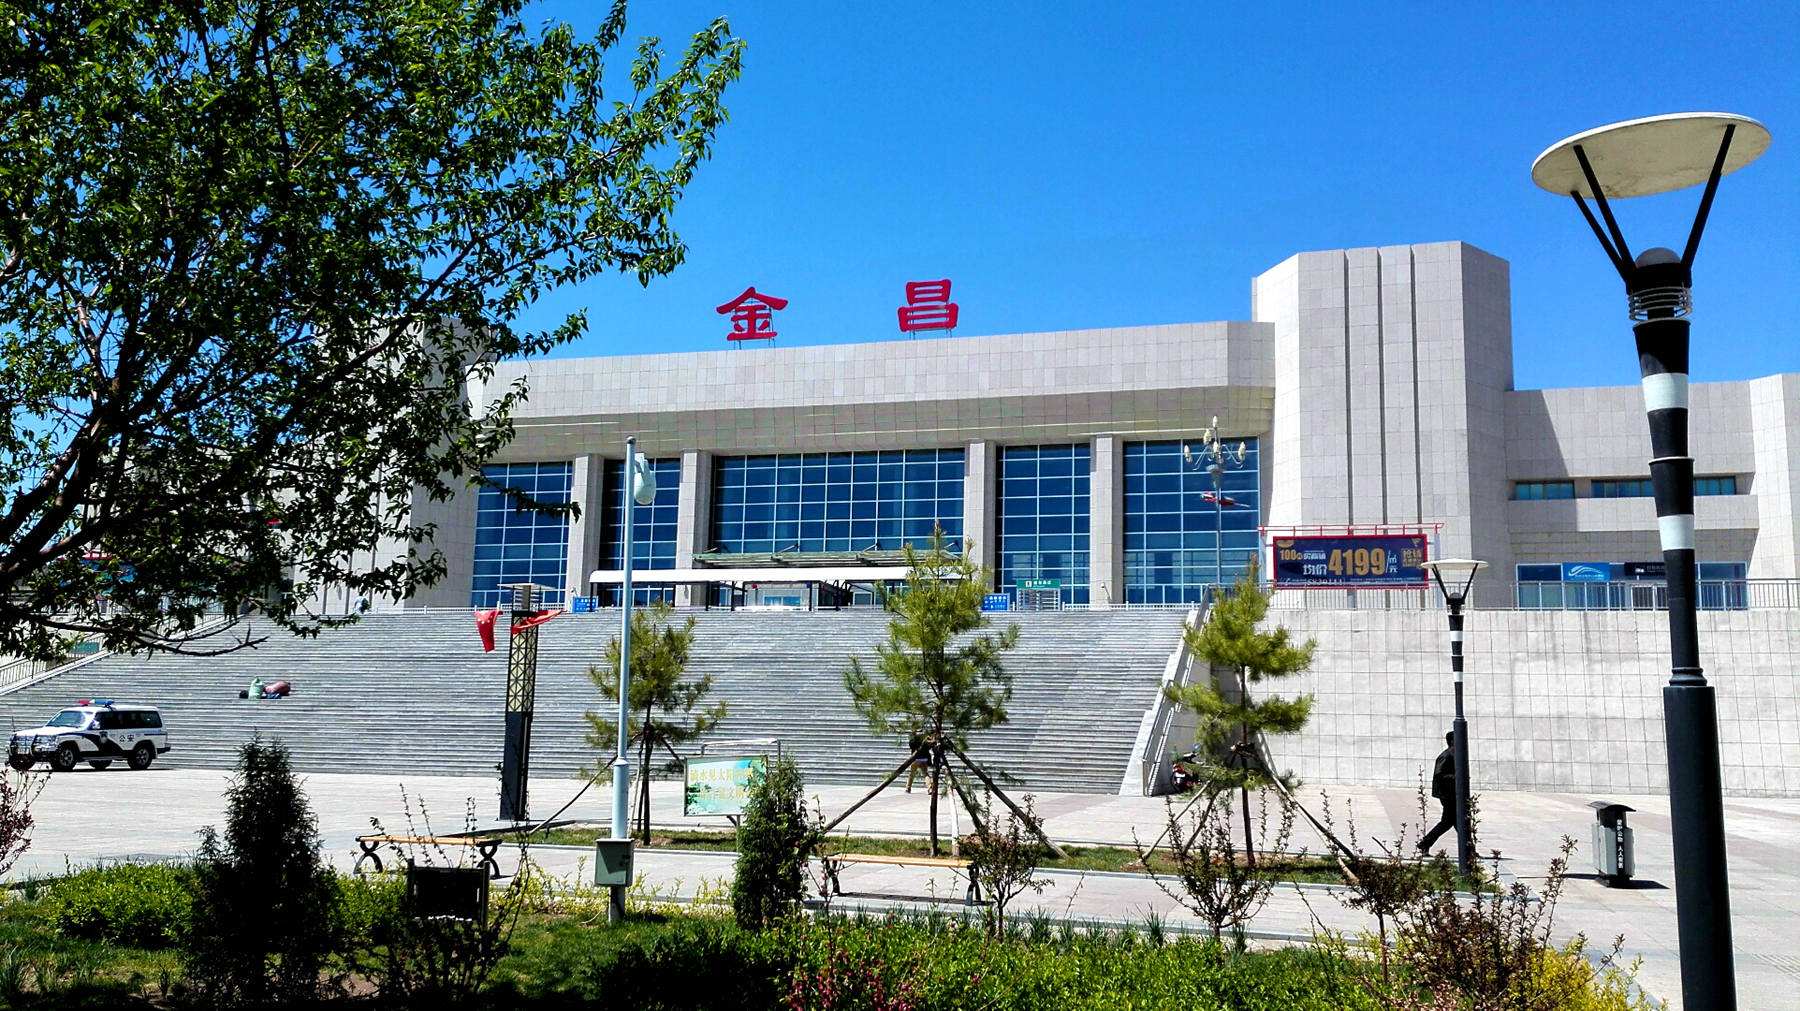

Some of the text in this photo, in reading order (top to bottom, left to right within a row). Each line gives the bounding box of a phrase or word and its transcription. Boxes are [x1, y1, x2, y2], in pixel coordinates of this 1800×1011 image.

[716, 278, 960, 341] 金昌
[1327, 548, 1386, 577] 4199
[119, 734, 135, 743] 公安
